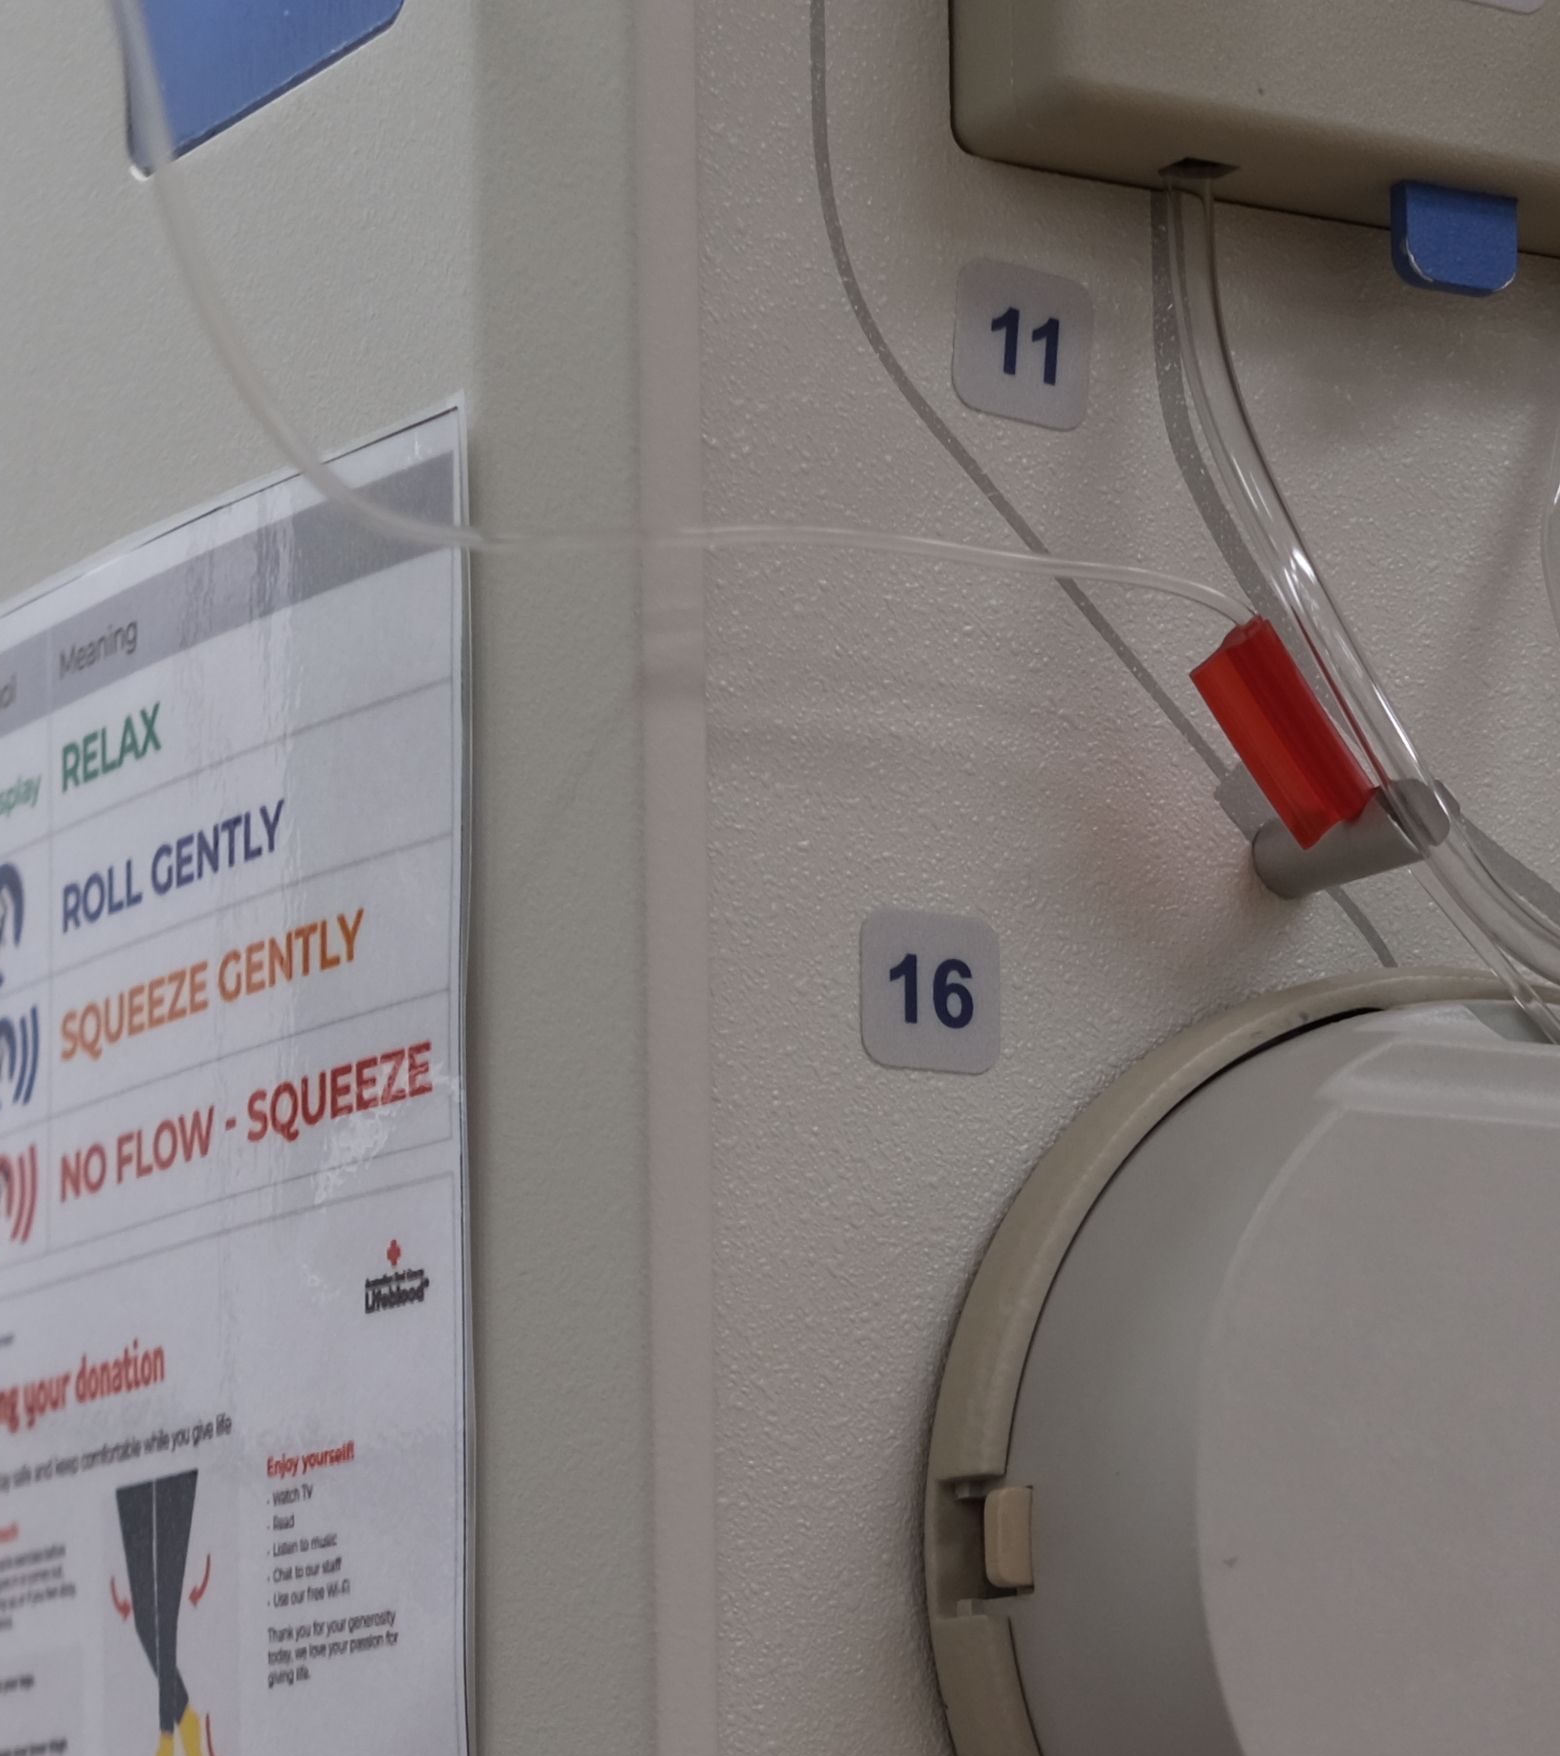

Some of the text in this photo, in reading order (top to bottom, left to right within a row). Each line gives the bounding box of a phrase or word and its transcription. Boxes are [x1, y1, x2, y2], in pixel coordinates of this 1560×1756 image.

[990, 306, 1061, 386] 11
[58, 620, 138, 679] Meaning
[62, 702, 161, 793] RELAX
[62, 798, 285, 933] ROLL GENTLY
[60, 908, 364, 1062] SQUEEZE GENTLY
[889, 953, 974, 1029] 16
[59, 1142, 106, 1202] NO
[116, 1105, 214, 1185] FLOW
[247, 1041, 432, 1144] SQUEEZE
[24, 1371, 70, 1429] your
[75, 1338, 165, 1403] donation
[143, 1429, 170, 1453] while
[171, 1426, 190, 1451] you
[191, 1419, 214, 1448] give
[216, 1412, 232, 1438] life
[267, 1453, 299, 1479] Enjoy
[301, 1483, 313, 1499] TV
[300, 1539, 309, 1553] to
[273, 1566, 292, 1583] Chat
[295, 1565, 304, 1579] to
[305, 1563, 320, 1577] our
[273, 1591, 289, 1608] Use
[291, 1589, 305, 1605] our
[307, 1585, 325, 1602] free
[268, 1626, 293, 1643] Thank
[295, 1625, 311, 1642] you
[313, 1620, 325, 1636] for
[326, 1618, 346, 1638] your
[328, 1640, 348, 1659] your
[385, 1630, 398, 1646] for
